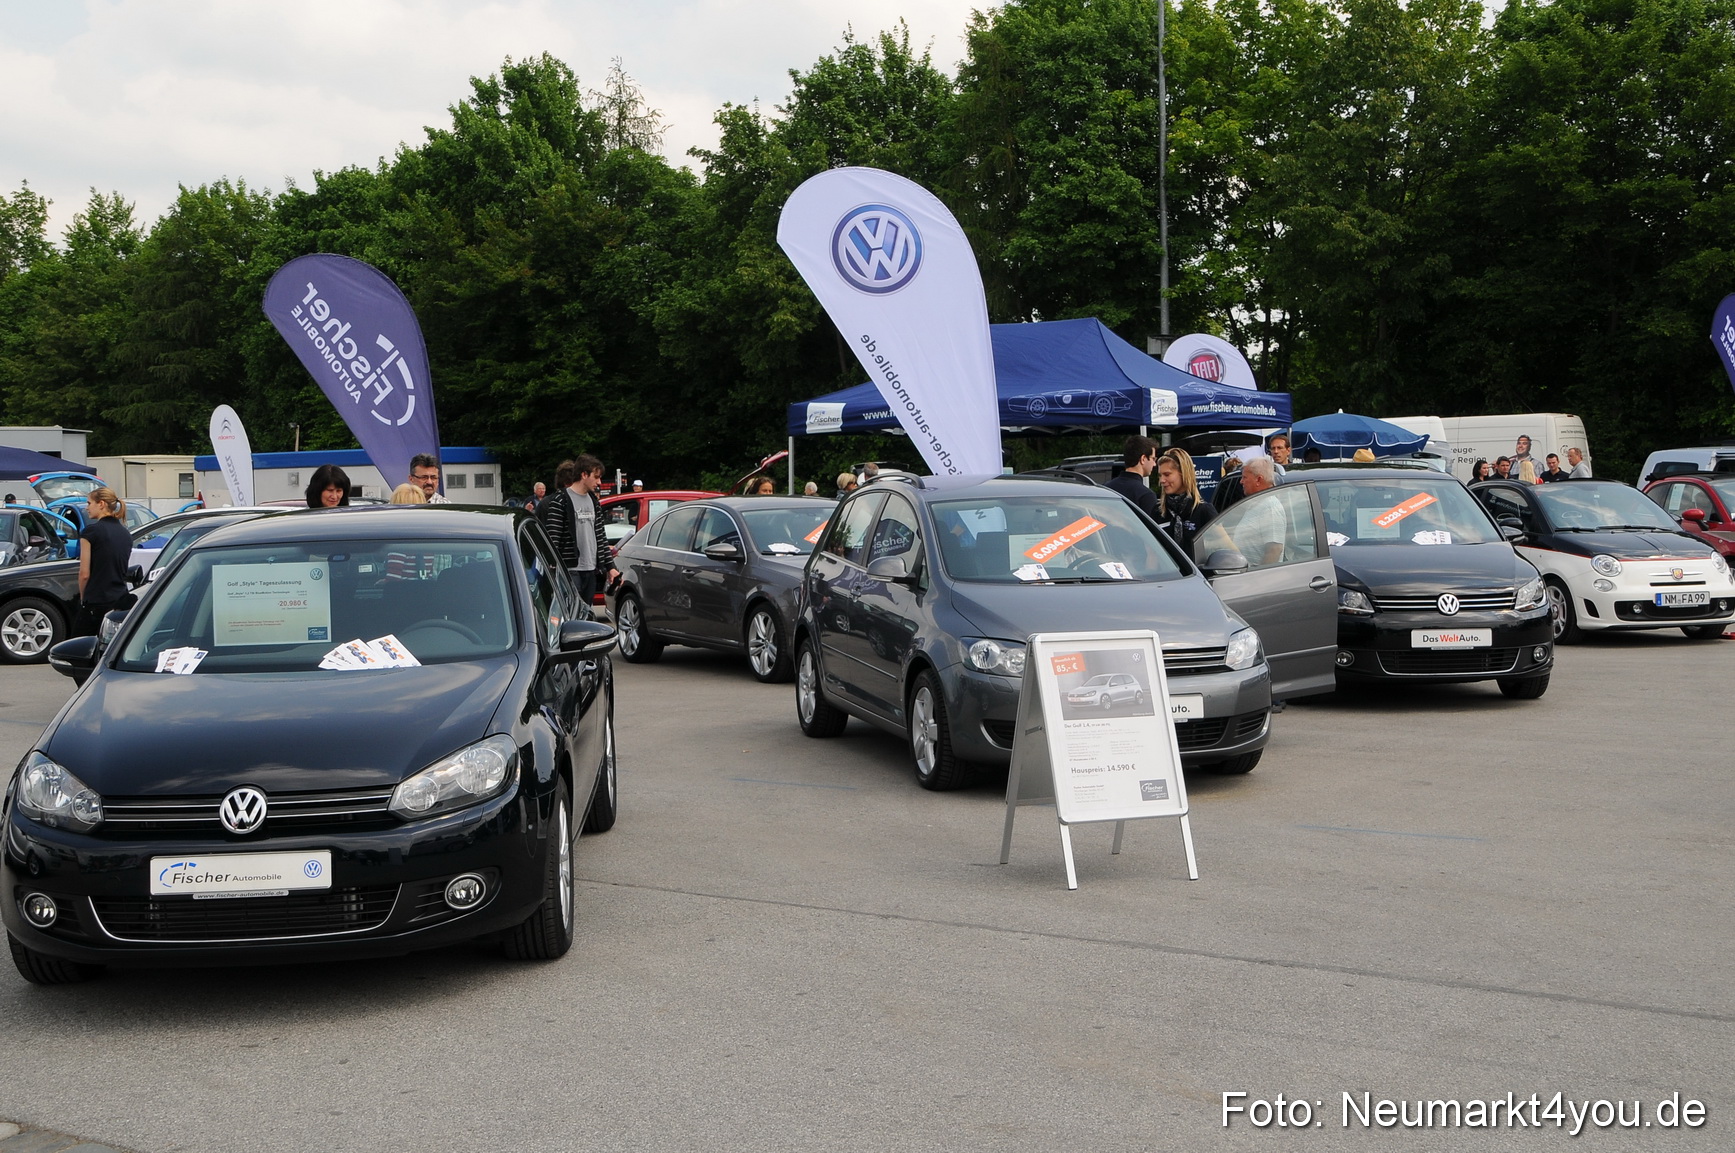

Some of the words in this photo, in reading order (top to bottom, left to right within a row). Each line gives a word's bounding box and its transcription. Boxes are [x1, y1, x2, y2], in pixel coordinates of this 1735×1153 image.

[1191, 402, 1276, 416] www.fischer-automobile.de
[1664, 594, 1677, 604] NM
[1681, 593, 1693, 603] FA
[1694, 593, 1706, 603] 99
[1422, 634, 1439, 643] Das
[1439, 633, 1481, 643] WeltAuto.
[1072, 662, 1078, 670] €
[1171, 704, 1190, 713] uto.
[1070, 766, 1106, 775] Hauspreis:
[1106, 763, 1130, 772] 14.590
[172, 872, 231, 884] Fischer
[232, 874, 282, 882] Automobile
[197, 890, 284, 899] www.fischer-automobile.de
